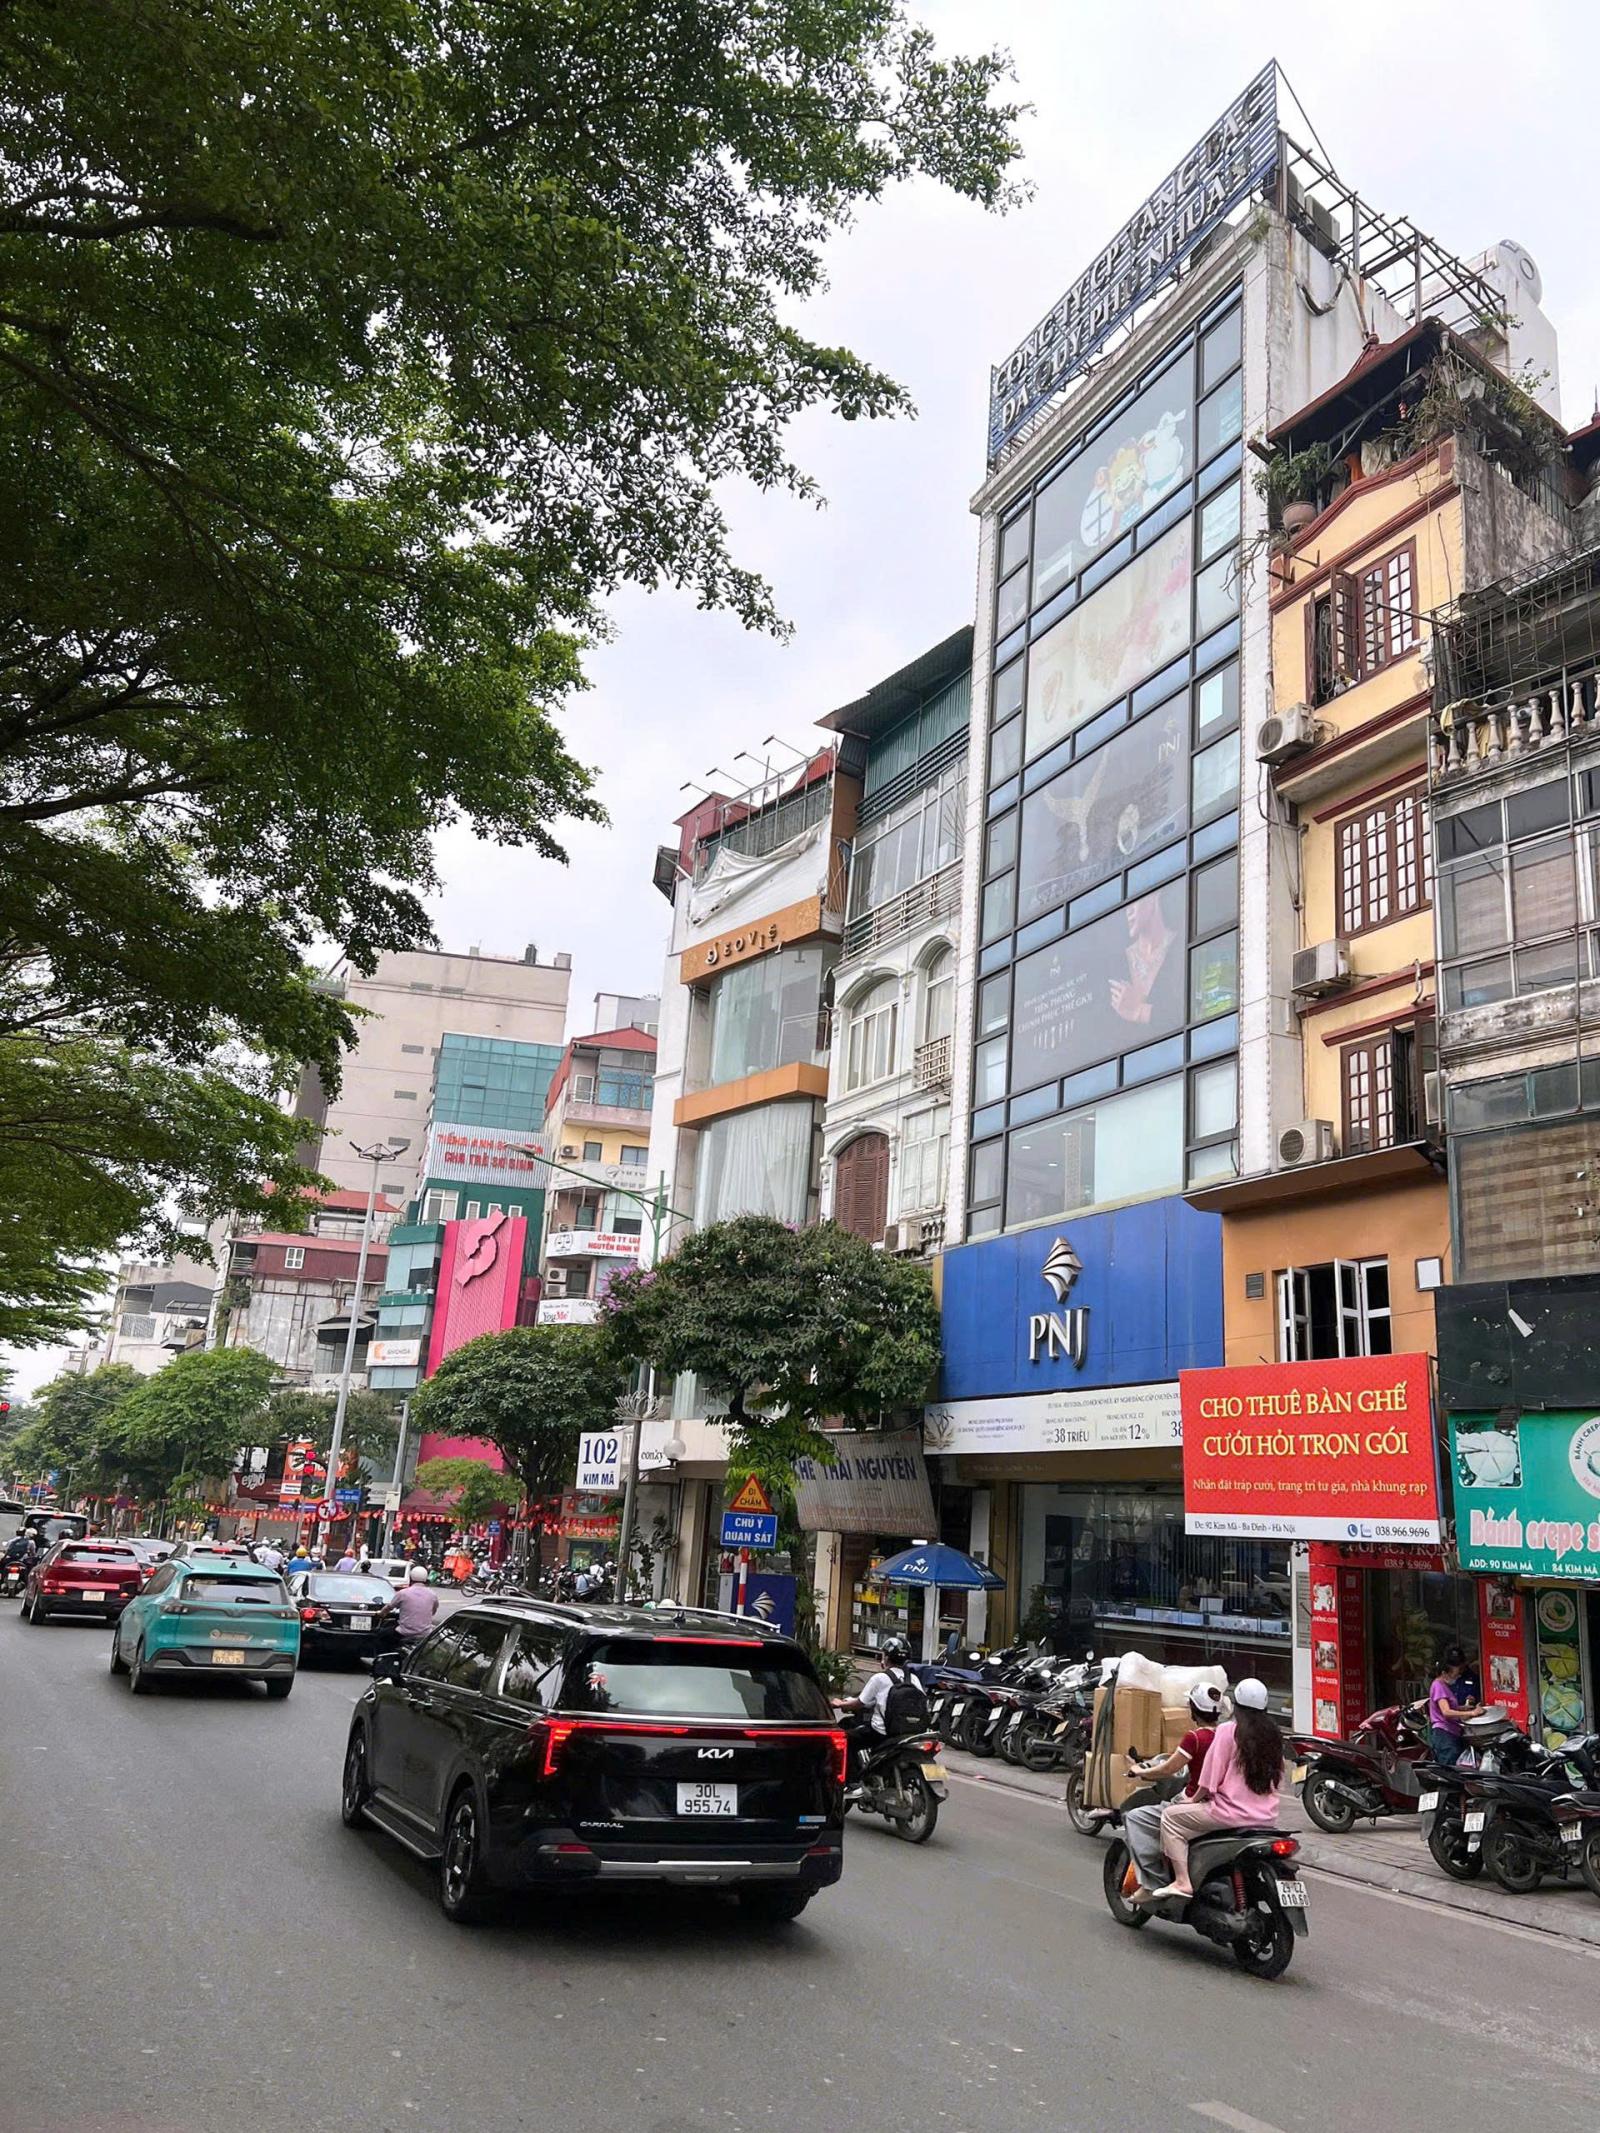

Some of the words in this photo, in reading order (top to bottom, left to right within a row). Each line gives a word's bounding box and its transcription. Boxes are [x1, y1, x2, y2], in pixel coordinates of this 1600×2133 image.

[1158, 733, 1181, 762] PNJ
[1029, 1305, 1090, 1371] PNJ
[1200, 1396, 1243, 1419] CHO
[1246, 1388, 1301, 1417] THUÊ
[1305, 1386, 1353, 1415] BÀN
[1358, 1381, 1408, 1413] GHẾ
[1054, 1427, 1066, 1443] 38
[1203, 1429, 1252, 1457] CƯỚI
[1258, 1428, 1297, 1456] HỎI
[1299, 1433, 1361, 1459] TRỌN
[1365, 1425, 1410, 1456] GÓI
[582, 1438, 619, 1465] 102
[582, 1473, 600, 1486] KIM
[1193, 1479, 1216, 1490] Nhận
[1278, 1481, 1303, 1494] trang
[1331, 1480, 1349, 1494] gia,
[1351, 1479, 1370, 1492] nhà
[1372, 1479, 1407, 1495] khung
[1409, 1481, 1428, 1496] rạp
[735, 1515, 754, 1528] CHÚ
[725, 1530, 752, 1542] QUAN
[754, 1531, 773, 1543] SÁT
[1375, 1526, 1430, 1538] 038.966.9696
[1470, 1506, 1523, 1548] Bánh
[1526, 1518, 1585, 1561] crepe
[902, 1563, 929, 1575] PNJ
[1469, 1559, 1489, 1569] ADD:
[1489, 1560, 1501, 1569] 90
[1501, 1560, 1519, 1570] KIM
[1552, 1563, 1563, 1573] 84
[1565, 1564, 1582, 1574] KIM
[697, 1748, 734, 1760] KIA
[695, 1784, 720, 1798] 30L
[684, 1799, 731, 1814] 955.74
